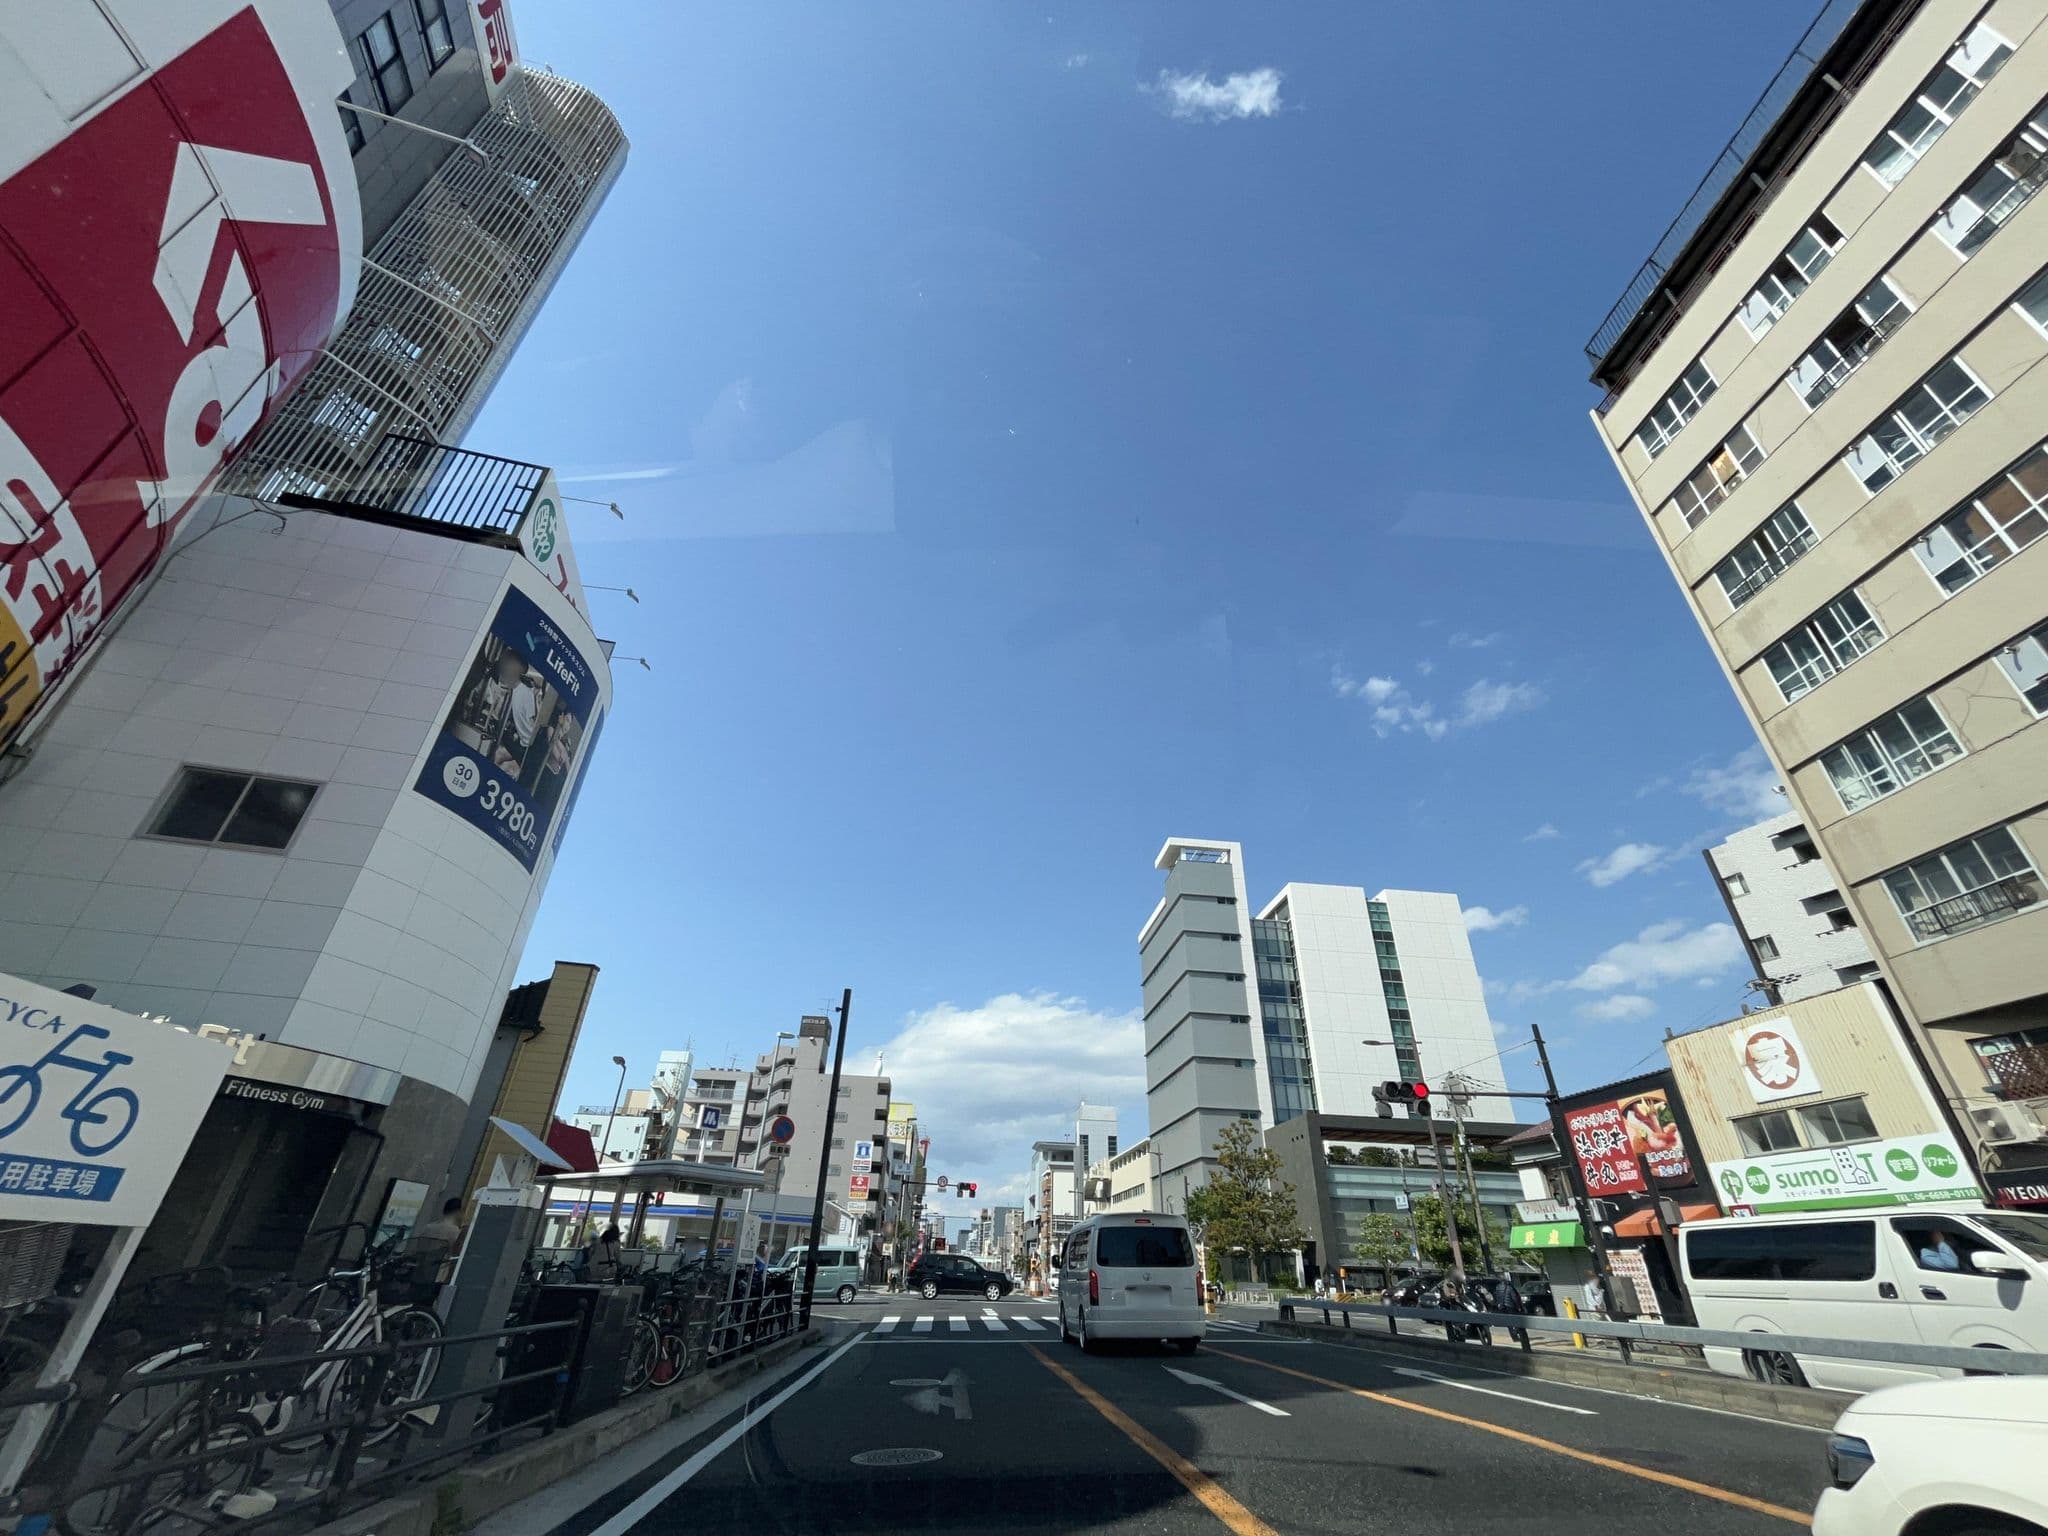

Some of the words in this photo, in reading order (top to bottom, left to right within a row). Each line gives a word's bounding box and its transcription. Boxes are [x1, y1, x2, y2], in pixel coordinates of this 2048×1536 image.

[546, 652, 580, 697] LifeFit
[454, 763, 473, 782] 30
[0, 998, 65, 1034] YCA
[225, 1079, 289, 1103] Fitness
[292, 1091, 325, 1110] Gym
[1574, 1125, 1627, 1160] 海鮮丼
[1586, 1161, 1619, 1189] 丼丸
[1888, 1156, 1918, 1173] 管理
[1924, 1155, 1957, 1169] リフォーム
[0, 1161, 100, 1196] 用駐車場
